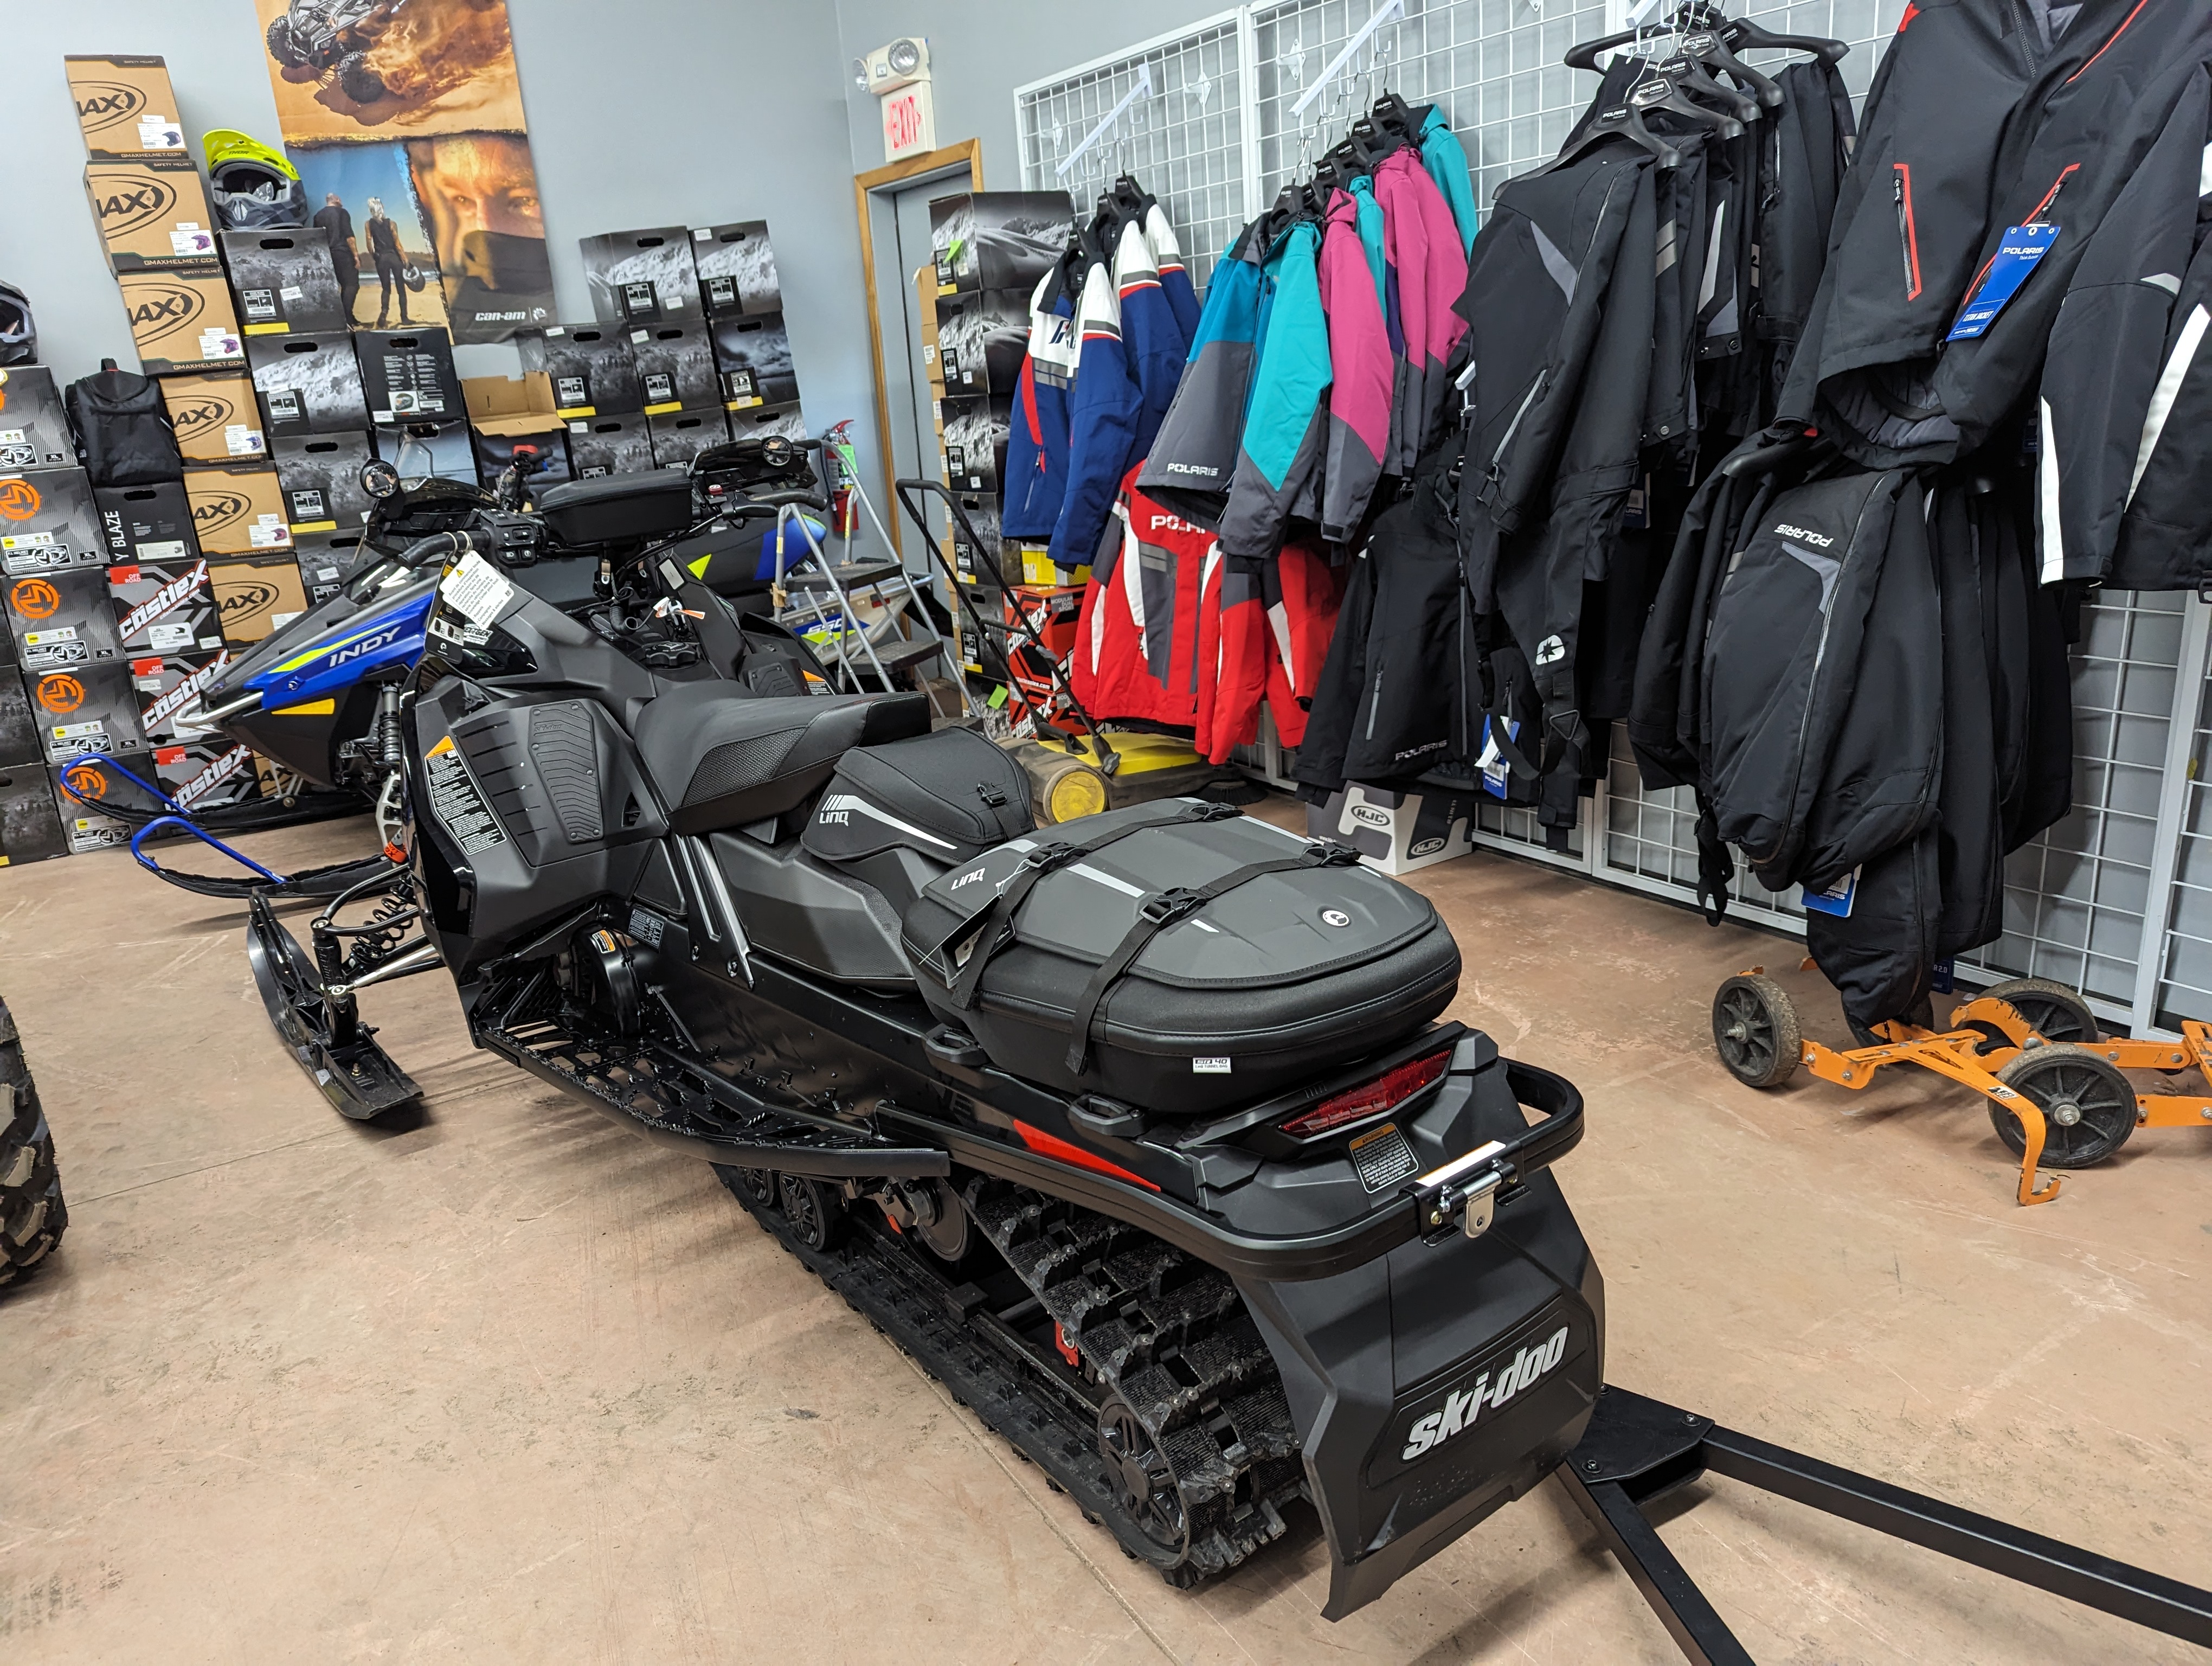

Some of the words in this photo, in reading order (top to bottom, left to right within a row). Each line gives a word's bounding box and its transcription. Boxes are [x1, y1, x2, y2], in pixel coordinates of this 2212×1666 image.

[1723, 28, 1737, 40] ARIS
[1660, 62, 1686, 72] POLARIS
[1638, 84, 1664, 95] POLARIS
[1603, 109, 1626, 118] POLARIS
[144, 258, 217, 266] GMAXHELMET.COM
[475, 310, 526, 322] can-am
[173, 361, 245, 370] GMAXHELMET.COM
[1167, 463, 1219, 477] POLARIS
[104, 510, 127, 548] BLAZE
[1774, 524, 1834, 548] POLARIS
[1051, 595, 1073, 604] MODULAR
[329, 626, 401, 668] INDY
[1395, 739, 1448, 761] POLARIS
[1484, 775, 1503, 787] POLARIS
[1356, 808, 1384, 823] HJC
[1416, 840, 1438, 853] HJC
[1402, 1327, 1568, 1460] ski-doo
